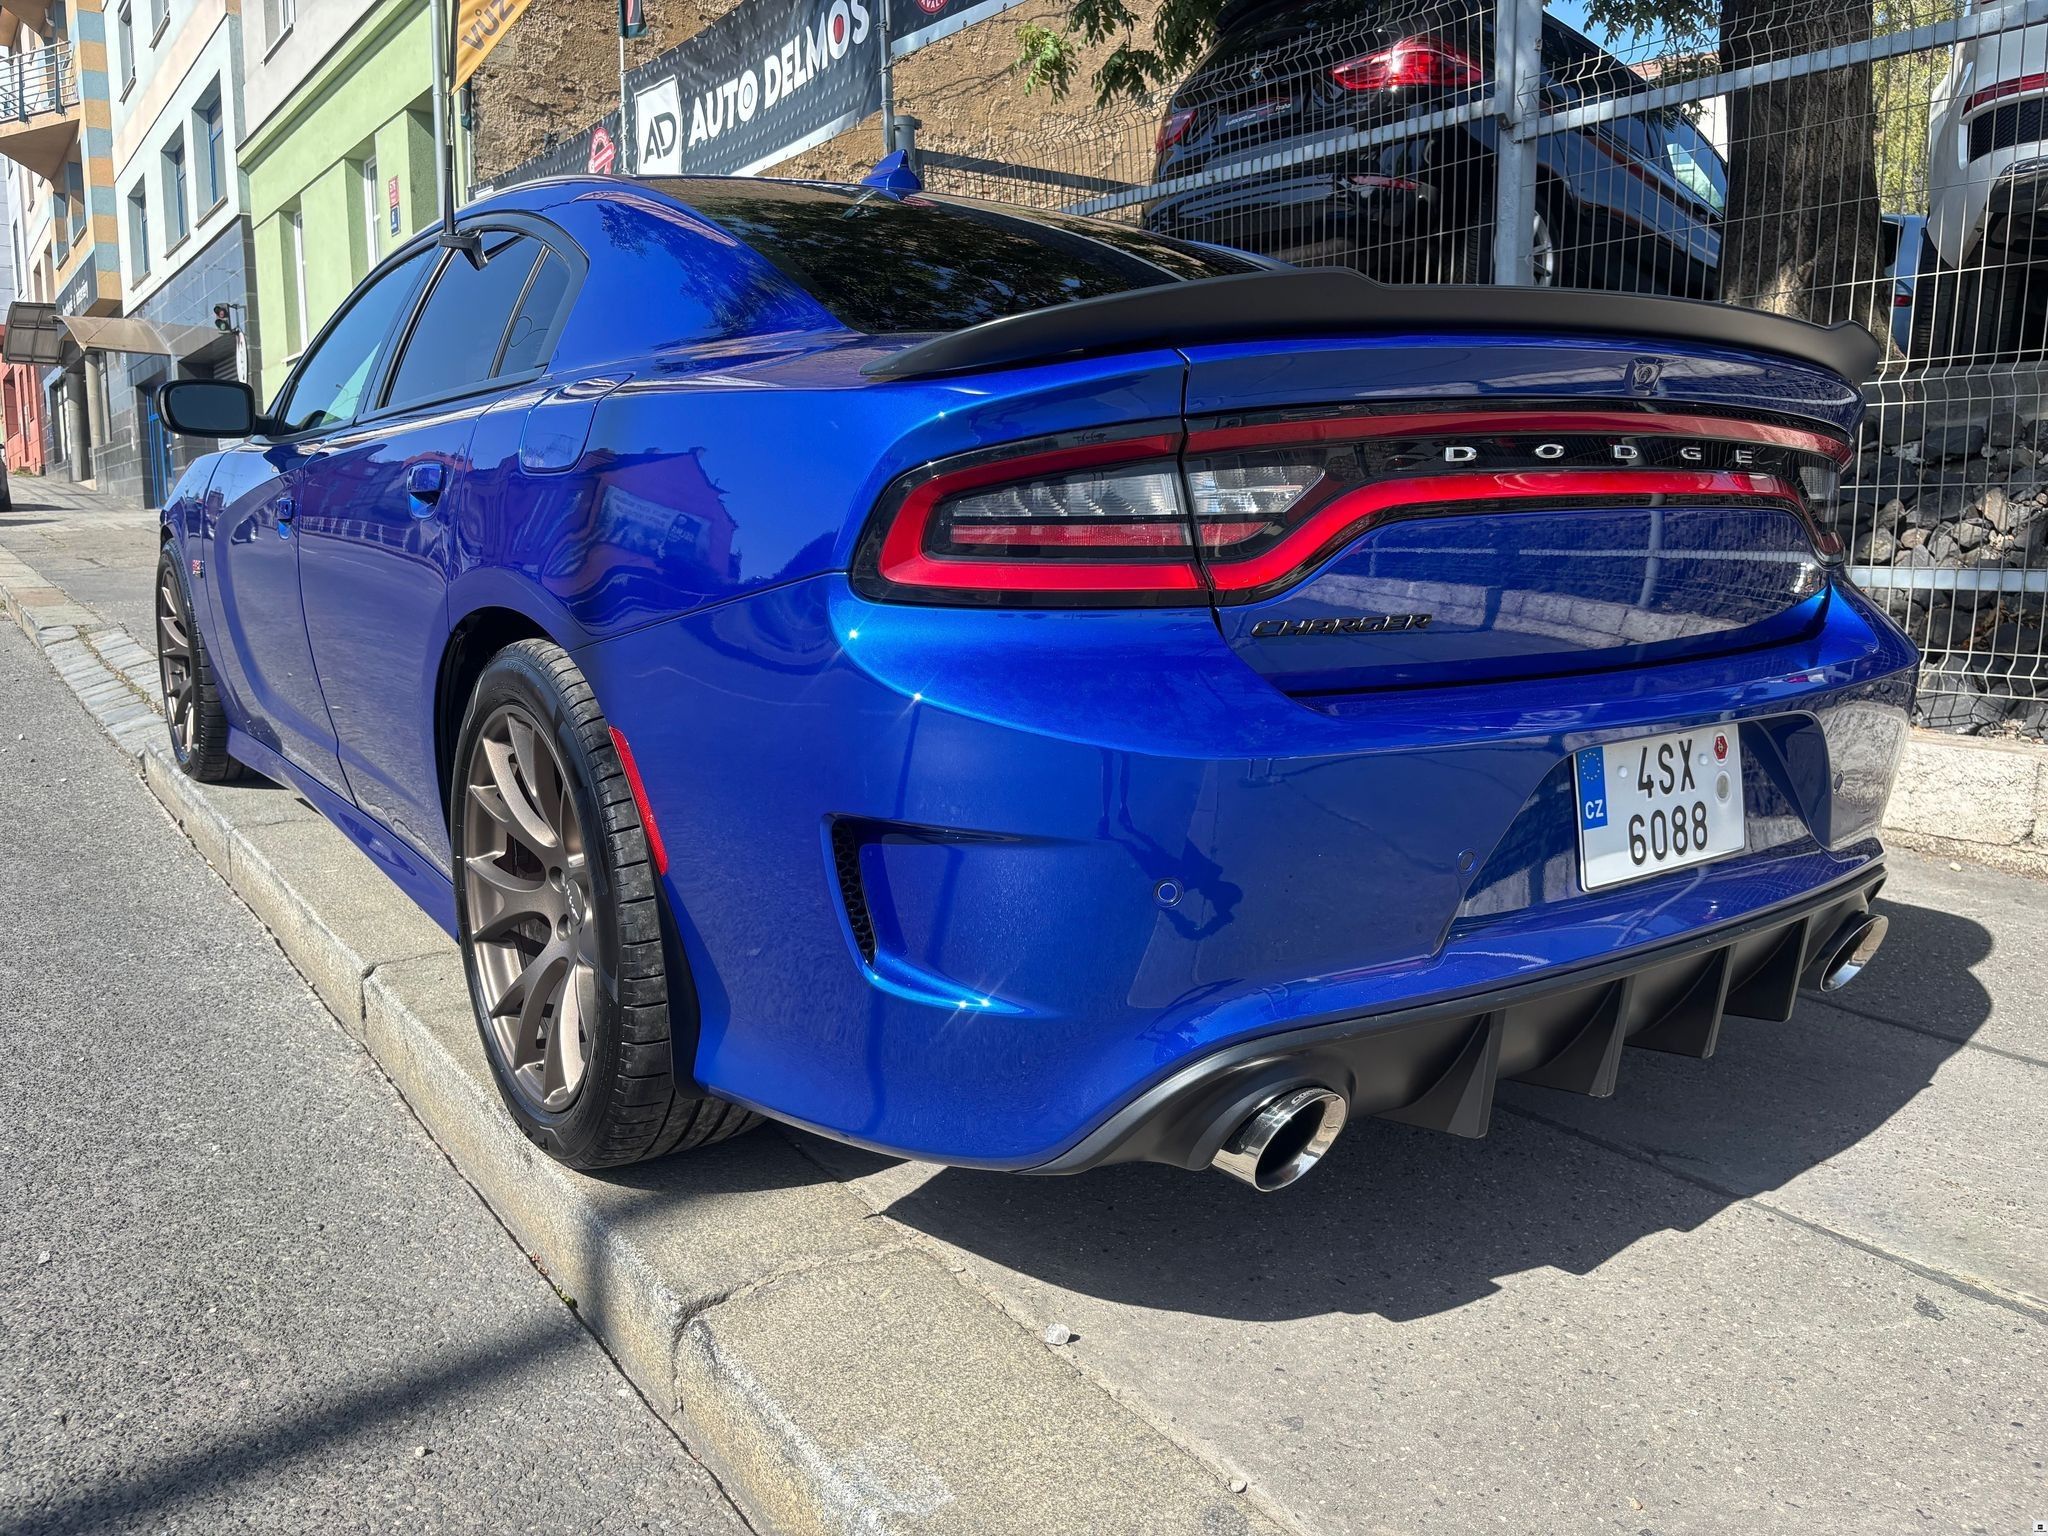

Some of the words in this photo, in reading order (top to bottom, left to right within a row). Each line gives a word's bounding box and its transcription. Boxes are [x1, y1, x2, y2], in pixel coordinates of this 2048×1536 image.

[688, 70, 759, 147] AUTO
[764, 0, 870, 110] DELMOS
[643, 111, 677, 164] AD
[1445, 444, 1753, 464] DODGE
[1251, 614, 1432, 637] CHARGER
[1637, 738, 1696, 799] 4SX
[1585, 799, 1604, 820] CZ
[1628, 800, 1708, 866] 6088
